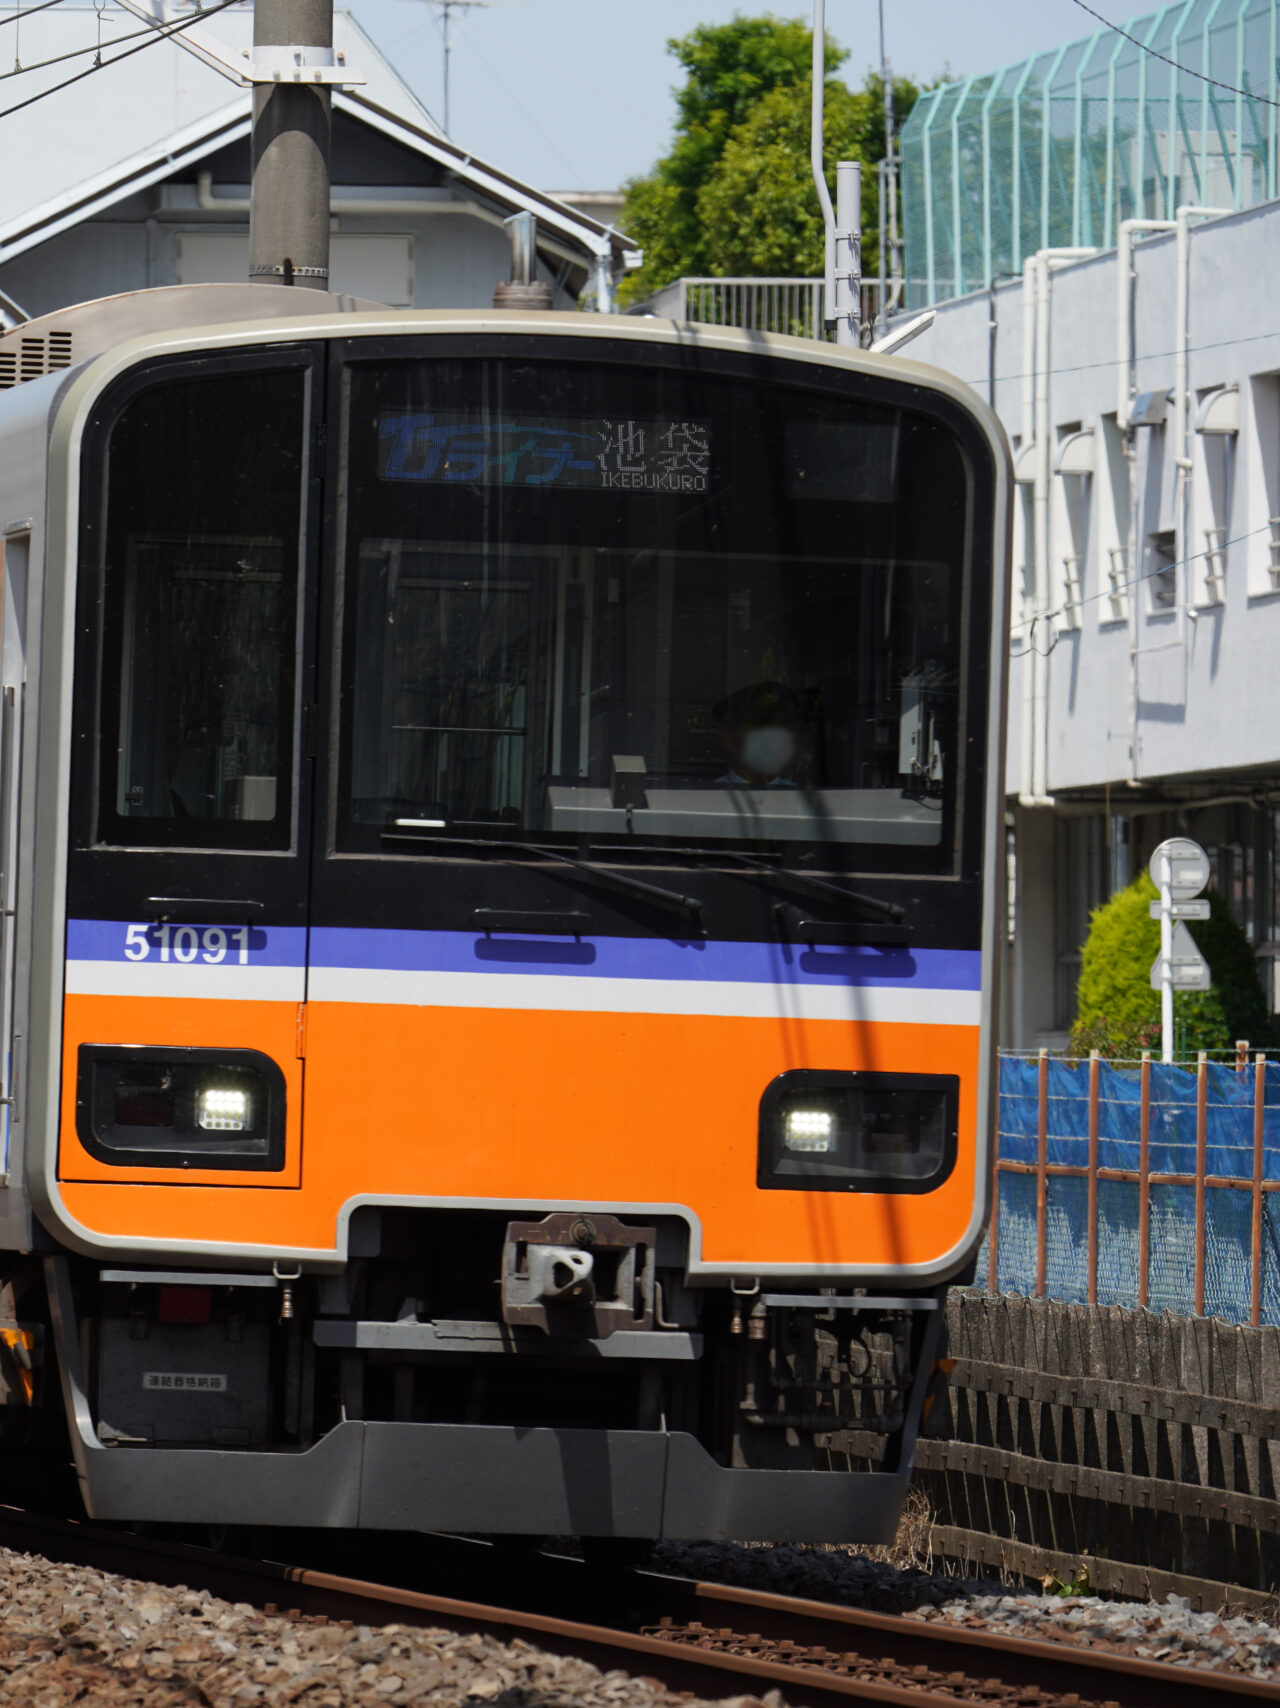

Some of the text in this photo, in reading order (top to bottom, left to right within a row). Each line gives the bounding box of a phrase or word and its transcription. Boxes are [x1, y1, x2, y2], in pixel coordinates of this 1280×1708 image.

[597, 419, 710, 472] 池袋
[601, 472, 708, 491] IKEBUKURO
[124, 924, 249, 965] 51091
